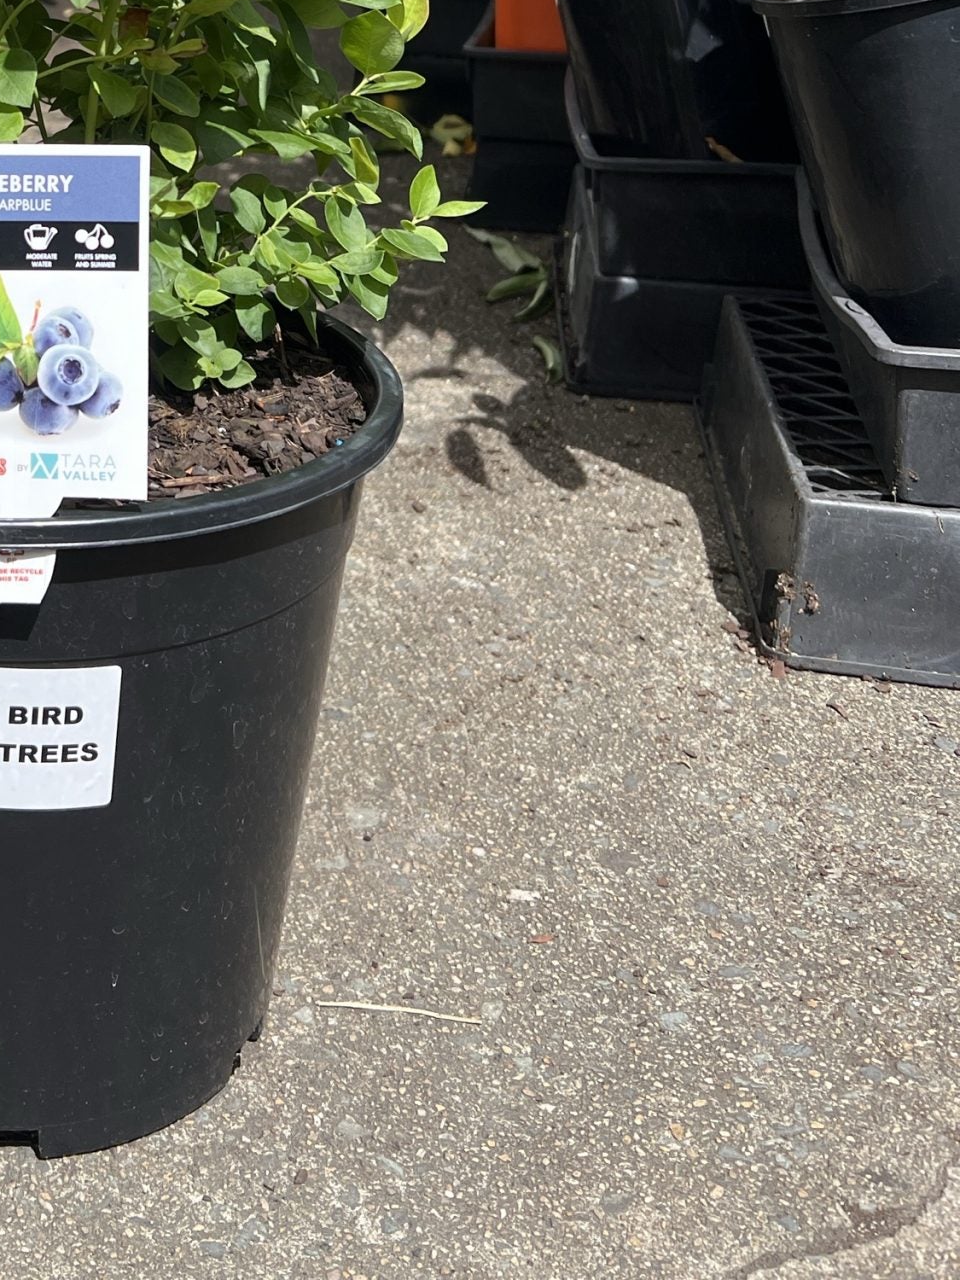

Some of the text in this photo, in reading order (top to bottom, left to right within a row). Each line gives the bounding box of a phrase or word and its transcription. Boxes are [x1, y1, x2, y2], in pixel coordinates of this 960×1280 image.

[75, 261, 116, 269] AND SUMMER
[61, 453, 117, 469] TARA
[17, 464, 28, 472] BY
[63, 471, 116, 481] VALLEY
[8, 706, 83, 726] BIRD
